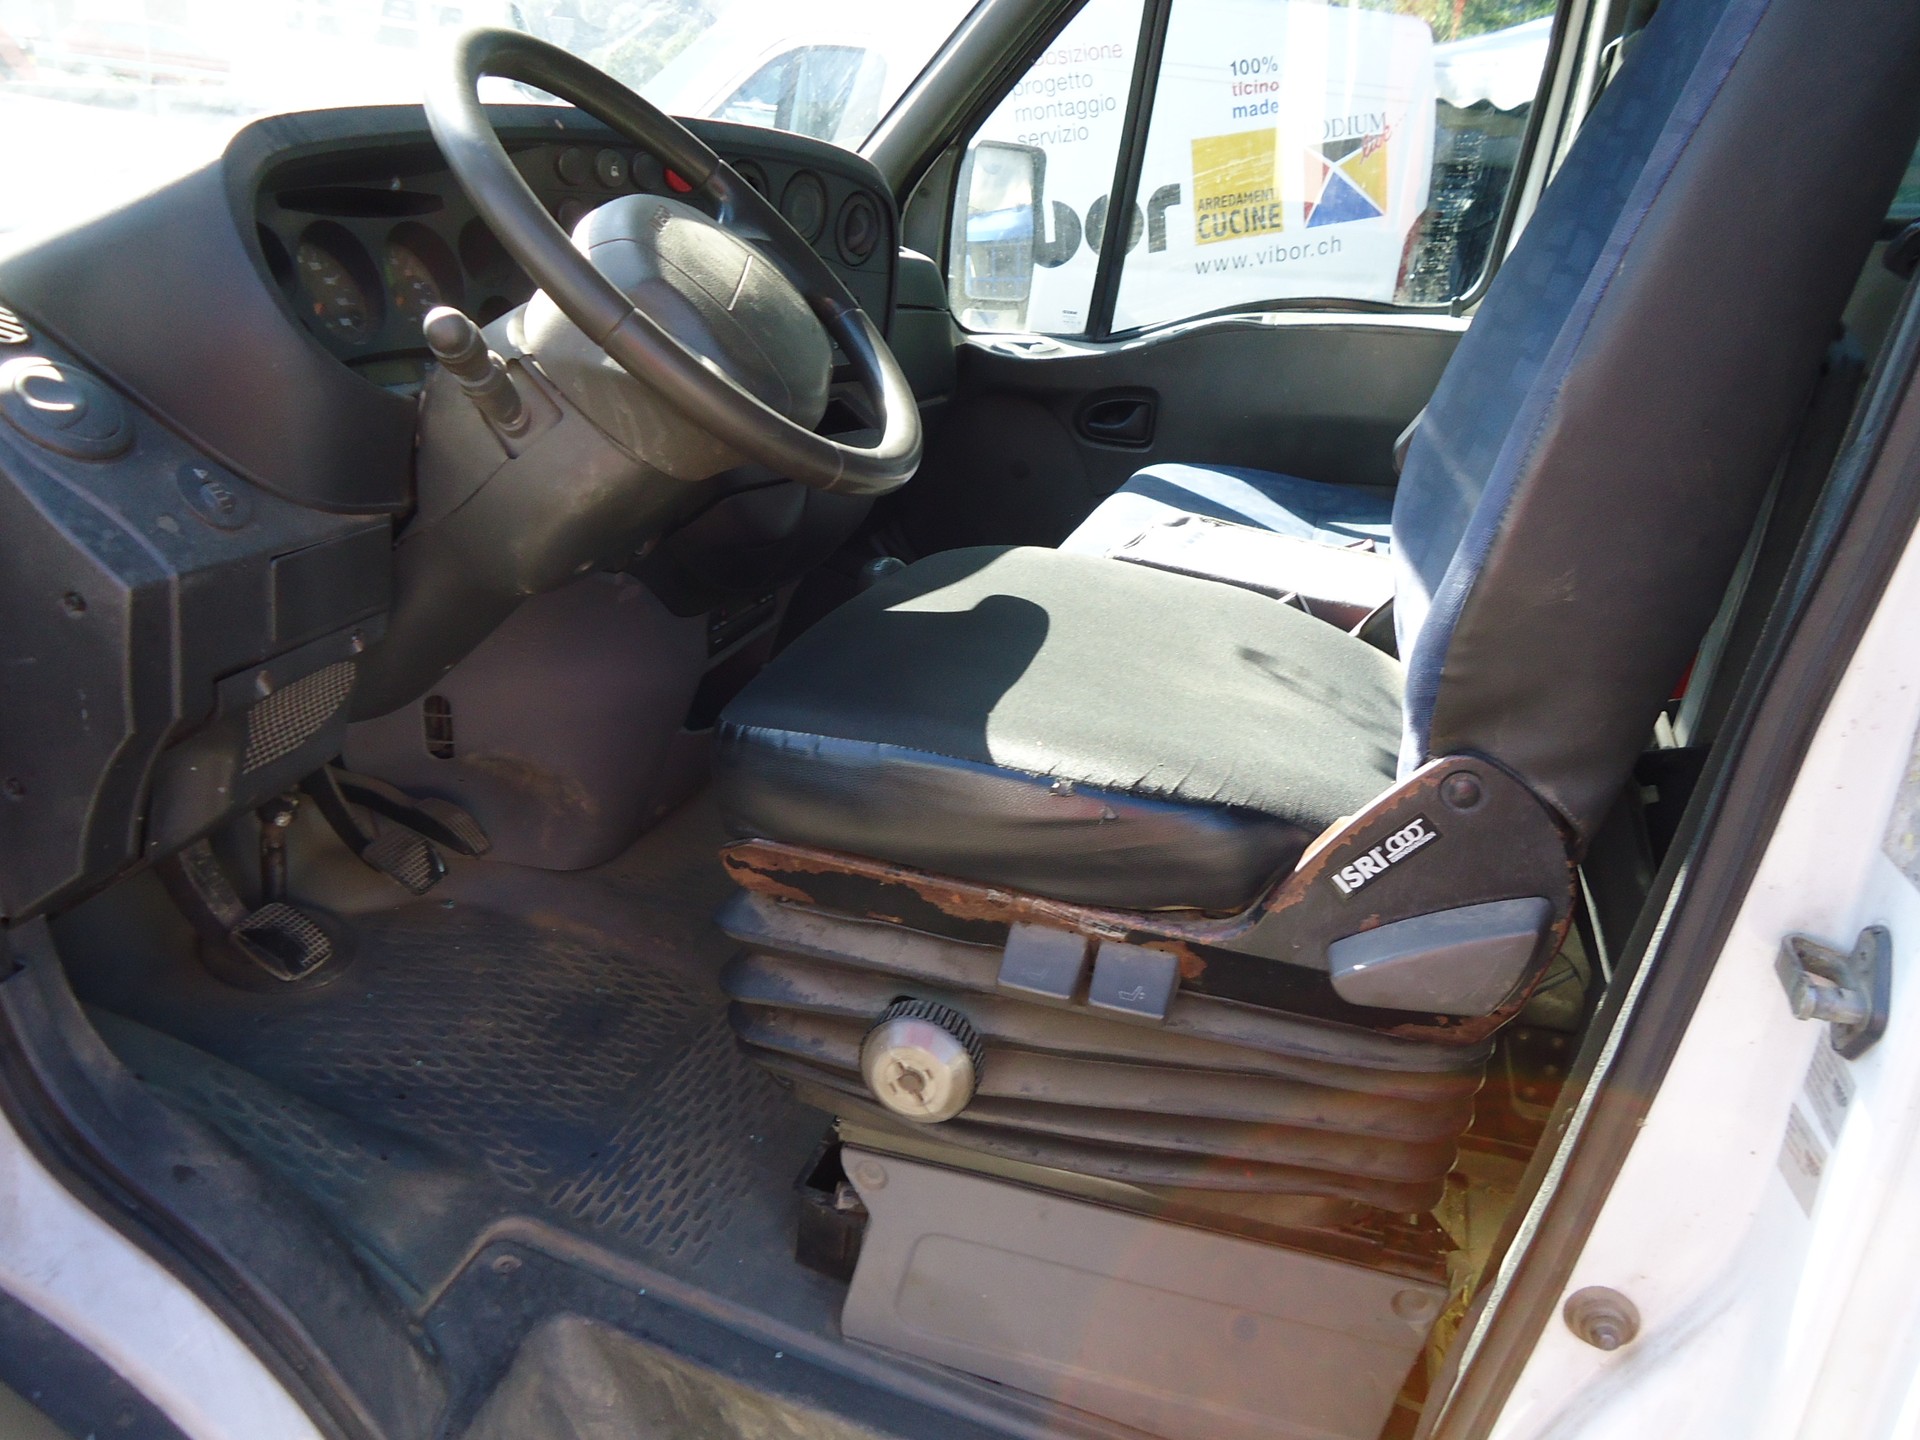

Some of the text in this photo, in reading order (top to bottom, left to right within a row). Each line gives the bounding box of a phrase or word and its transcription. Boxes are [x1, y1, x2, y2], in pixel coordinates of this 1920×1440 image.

[1230, 56, 1279, 77] 100%
[1013, 72, 1094, 101] progetto
[1232, 80, 1280, 96] ticino
[1015, 93, 1117, 123] montaggio
[1232, 99, 1279, 119] made
[1017, 123, 1089, 147] servizio
[1197, 187, 1280, 212] ARREDAMENT
[1198, 203, 1281, 239] CUCINE
[1195, 235, 1342, 275] www.vibor.ch
[1331, 847, 1390, 894] ISRI
